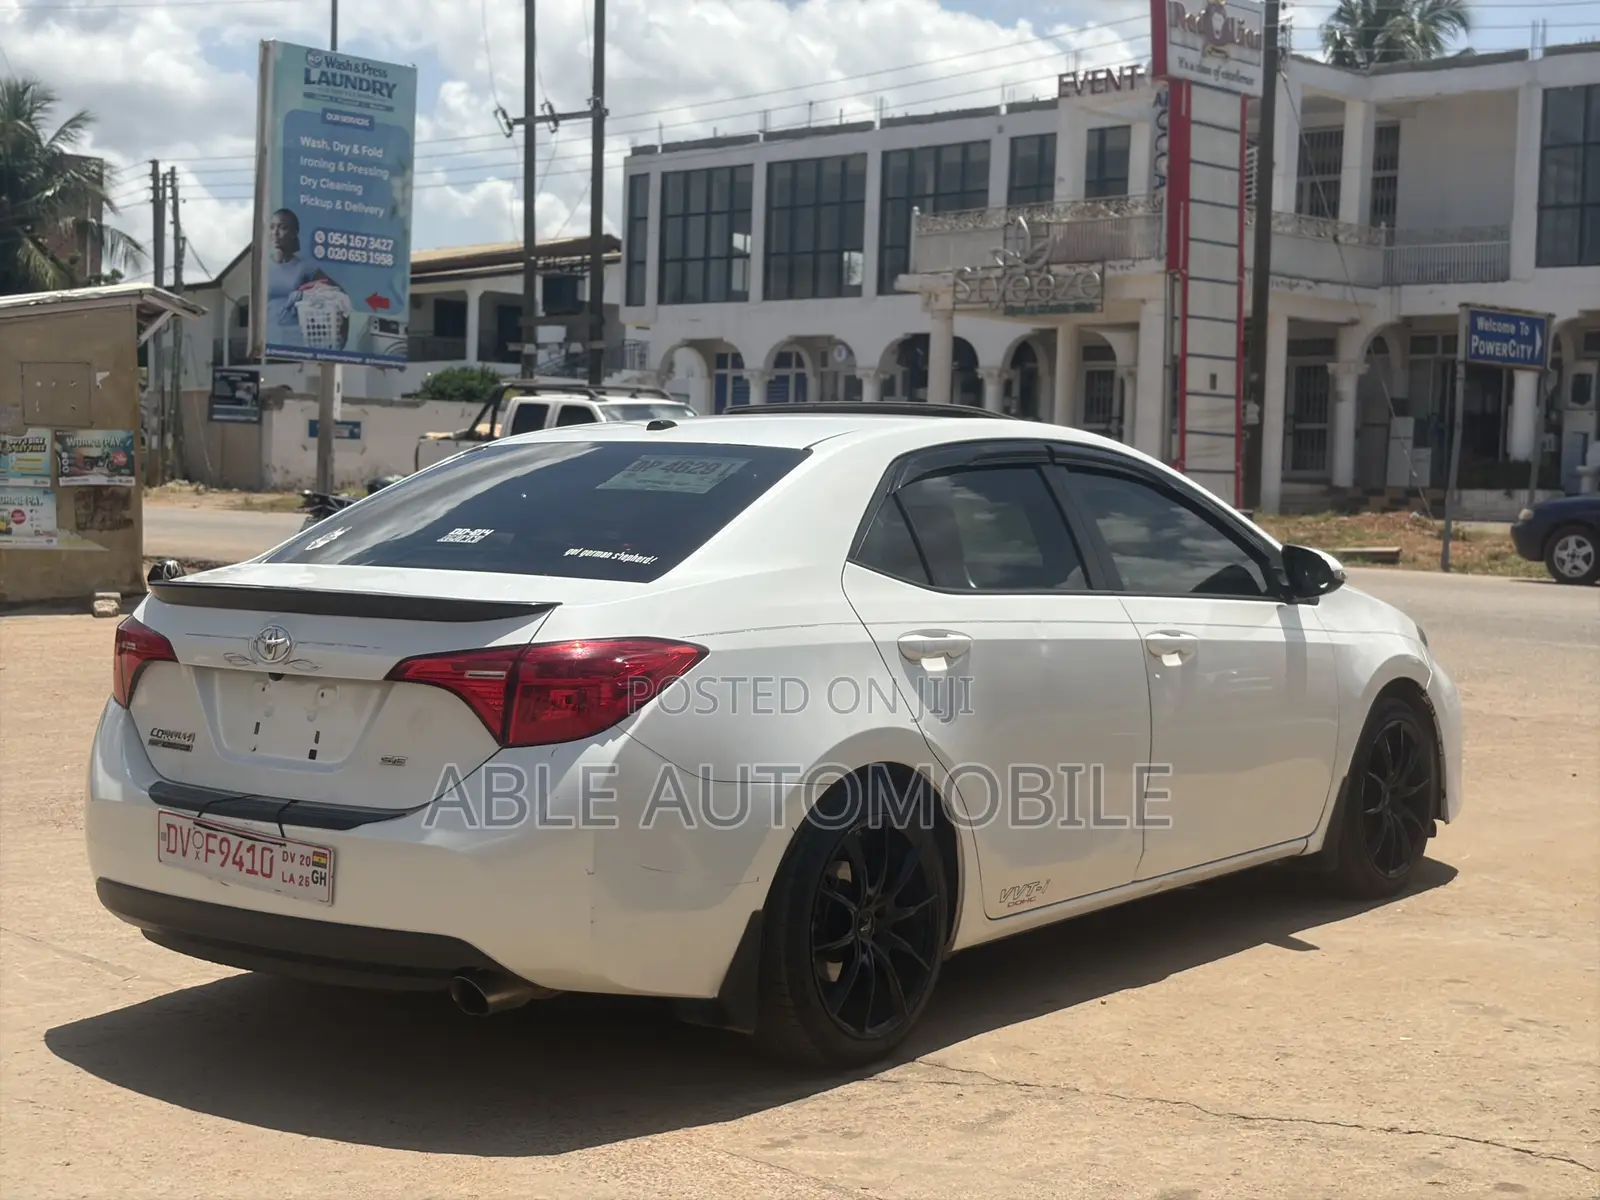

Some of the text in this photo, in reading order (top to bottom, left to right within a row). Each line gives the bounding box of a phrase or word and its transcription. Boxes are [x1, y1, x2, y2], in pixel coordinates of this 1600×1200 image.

[325, 55, 353, 72] Wash
[353, 61, 361, 74] &
[362, 62, 388, 79] Press
[304, 67, 398, 100] LAUNDRY
[1057, 64, 1145, 98] EVENT
[300, 135, 384, 158] Wash, Dry & Fold
[300, 155, 389, 181] Ironing & Pressing
[300, 175, 363, 196] Dry Cleaning
[300, 194, 385, 219] Pickup & Delivery
[327, 231, 394, 252] 054 167 3427
[327, 246, 348, 261] 020
[368, 252, 394, 267] 1958
[1476, 316, 1530, 337] Welcome To
[166, 822, 274, 880] DV F9410
[282, 850, 311, 868] DV 20
[281, 871, 296, 885] LA
[311, 869, 328, 887] GH
[1007, 896, 1037, 908] DOHC
